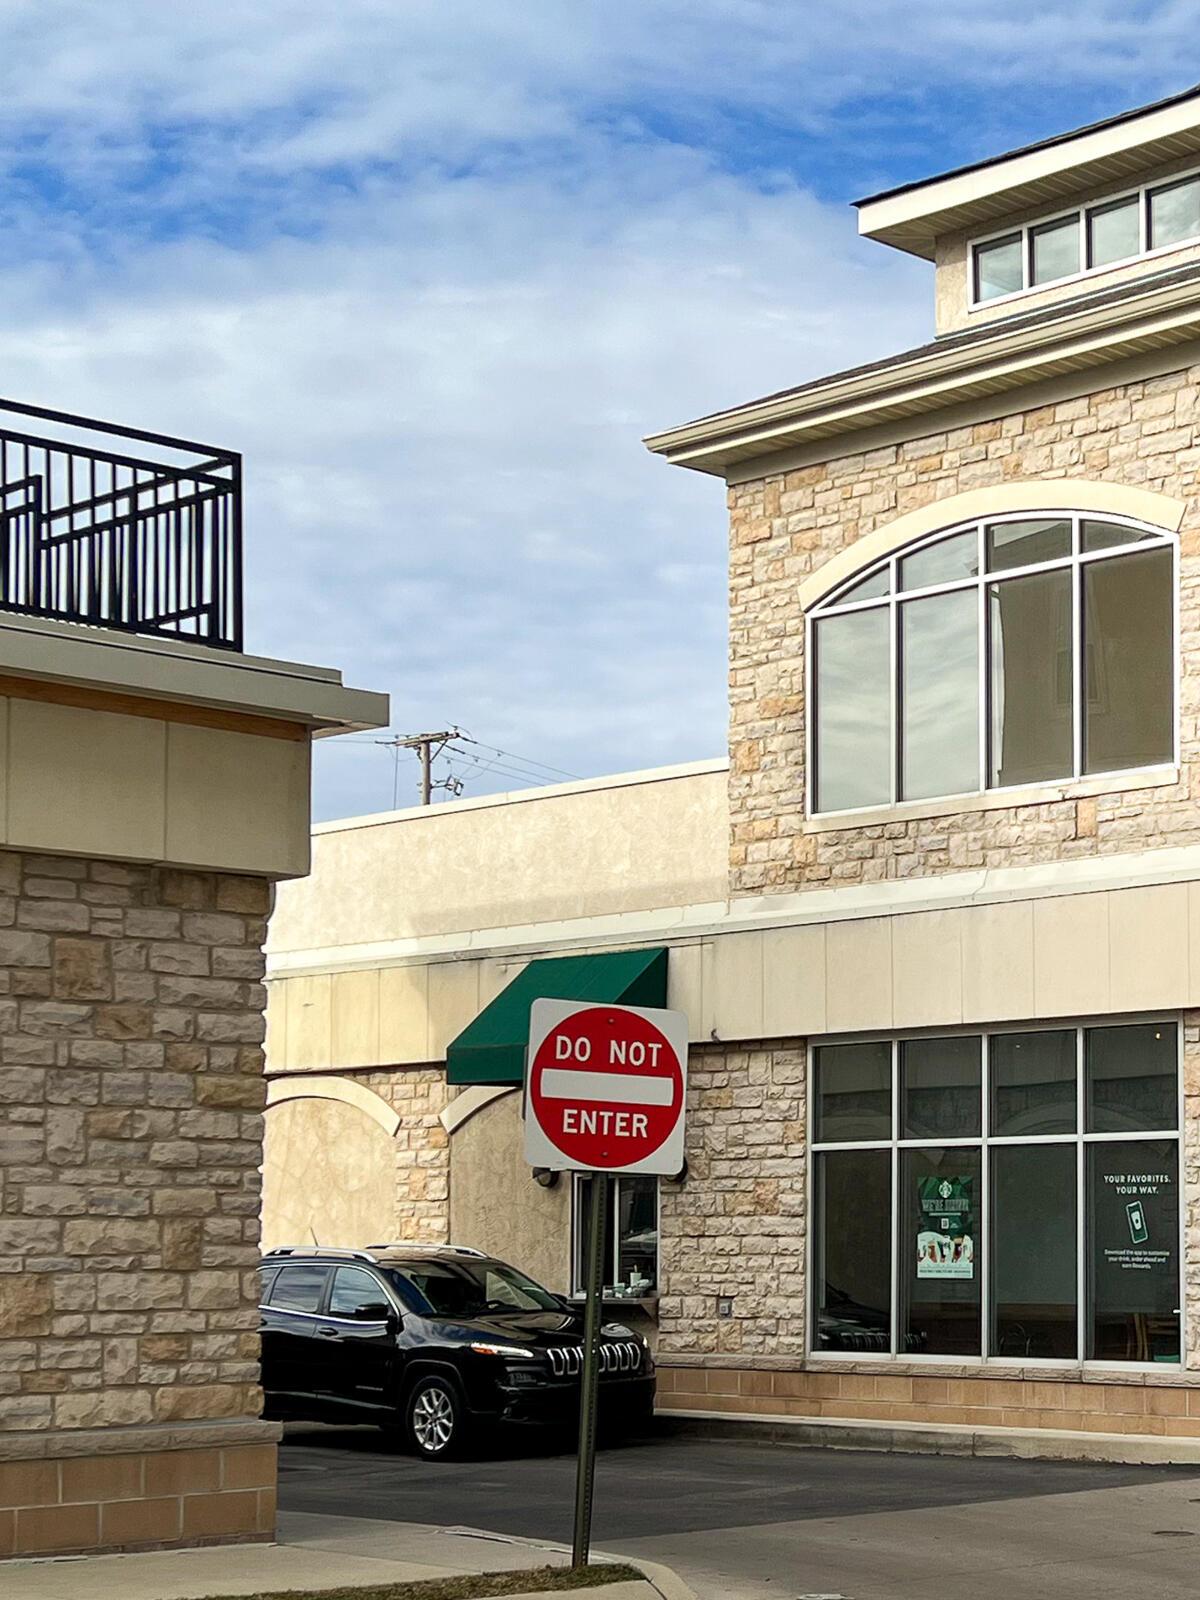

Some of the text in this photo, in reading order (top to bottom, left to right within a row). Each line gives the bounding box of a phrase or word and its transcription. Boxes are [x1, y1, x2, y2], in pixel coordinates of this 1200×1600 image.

[555, 1035, 663, 1068] DO NOT
[562, 1108, 649, 1138] ENTER
[1104, 1174, 1171, 1183] YOUR FAVORITES.
[1116, 1186, 1159, 1194] YOUR WAY.
